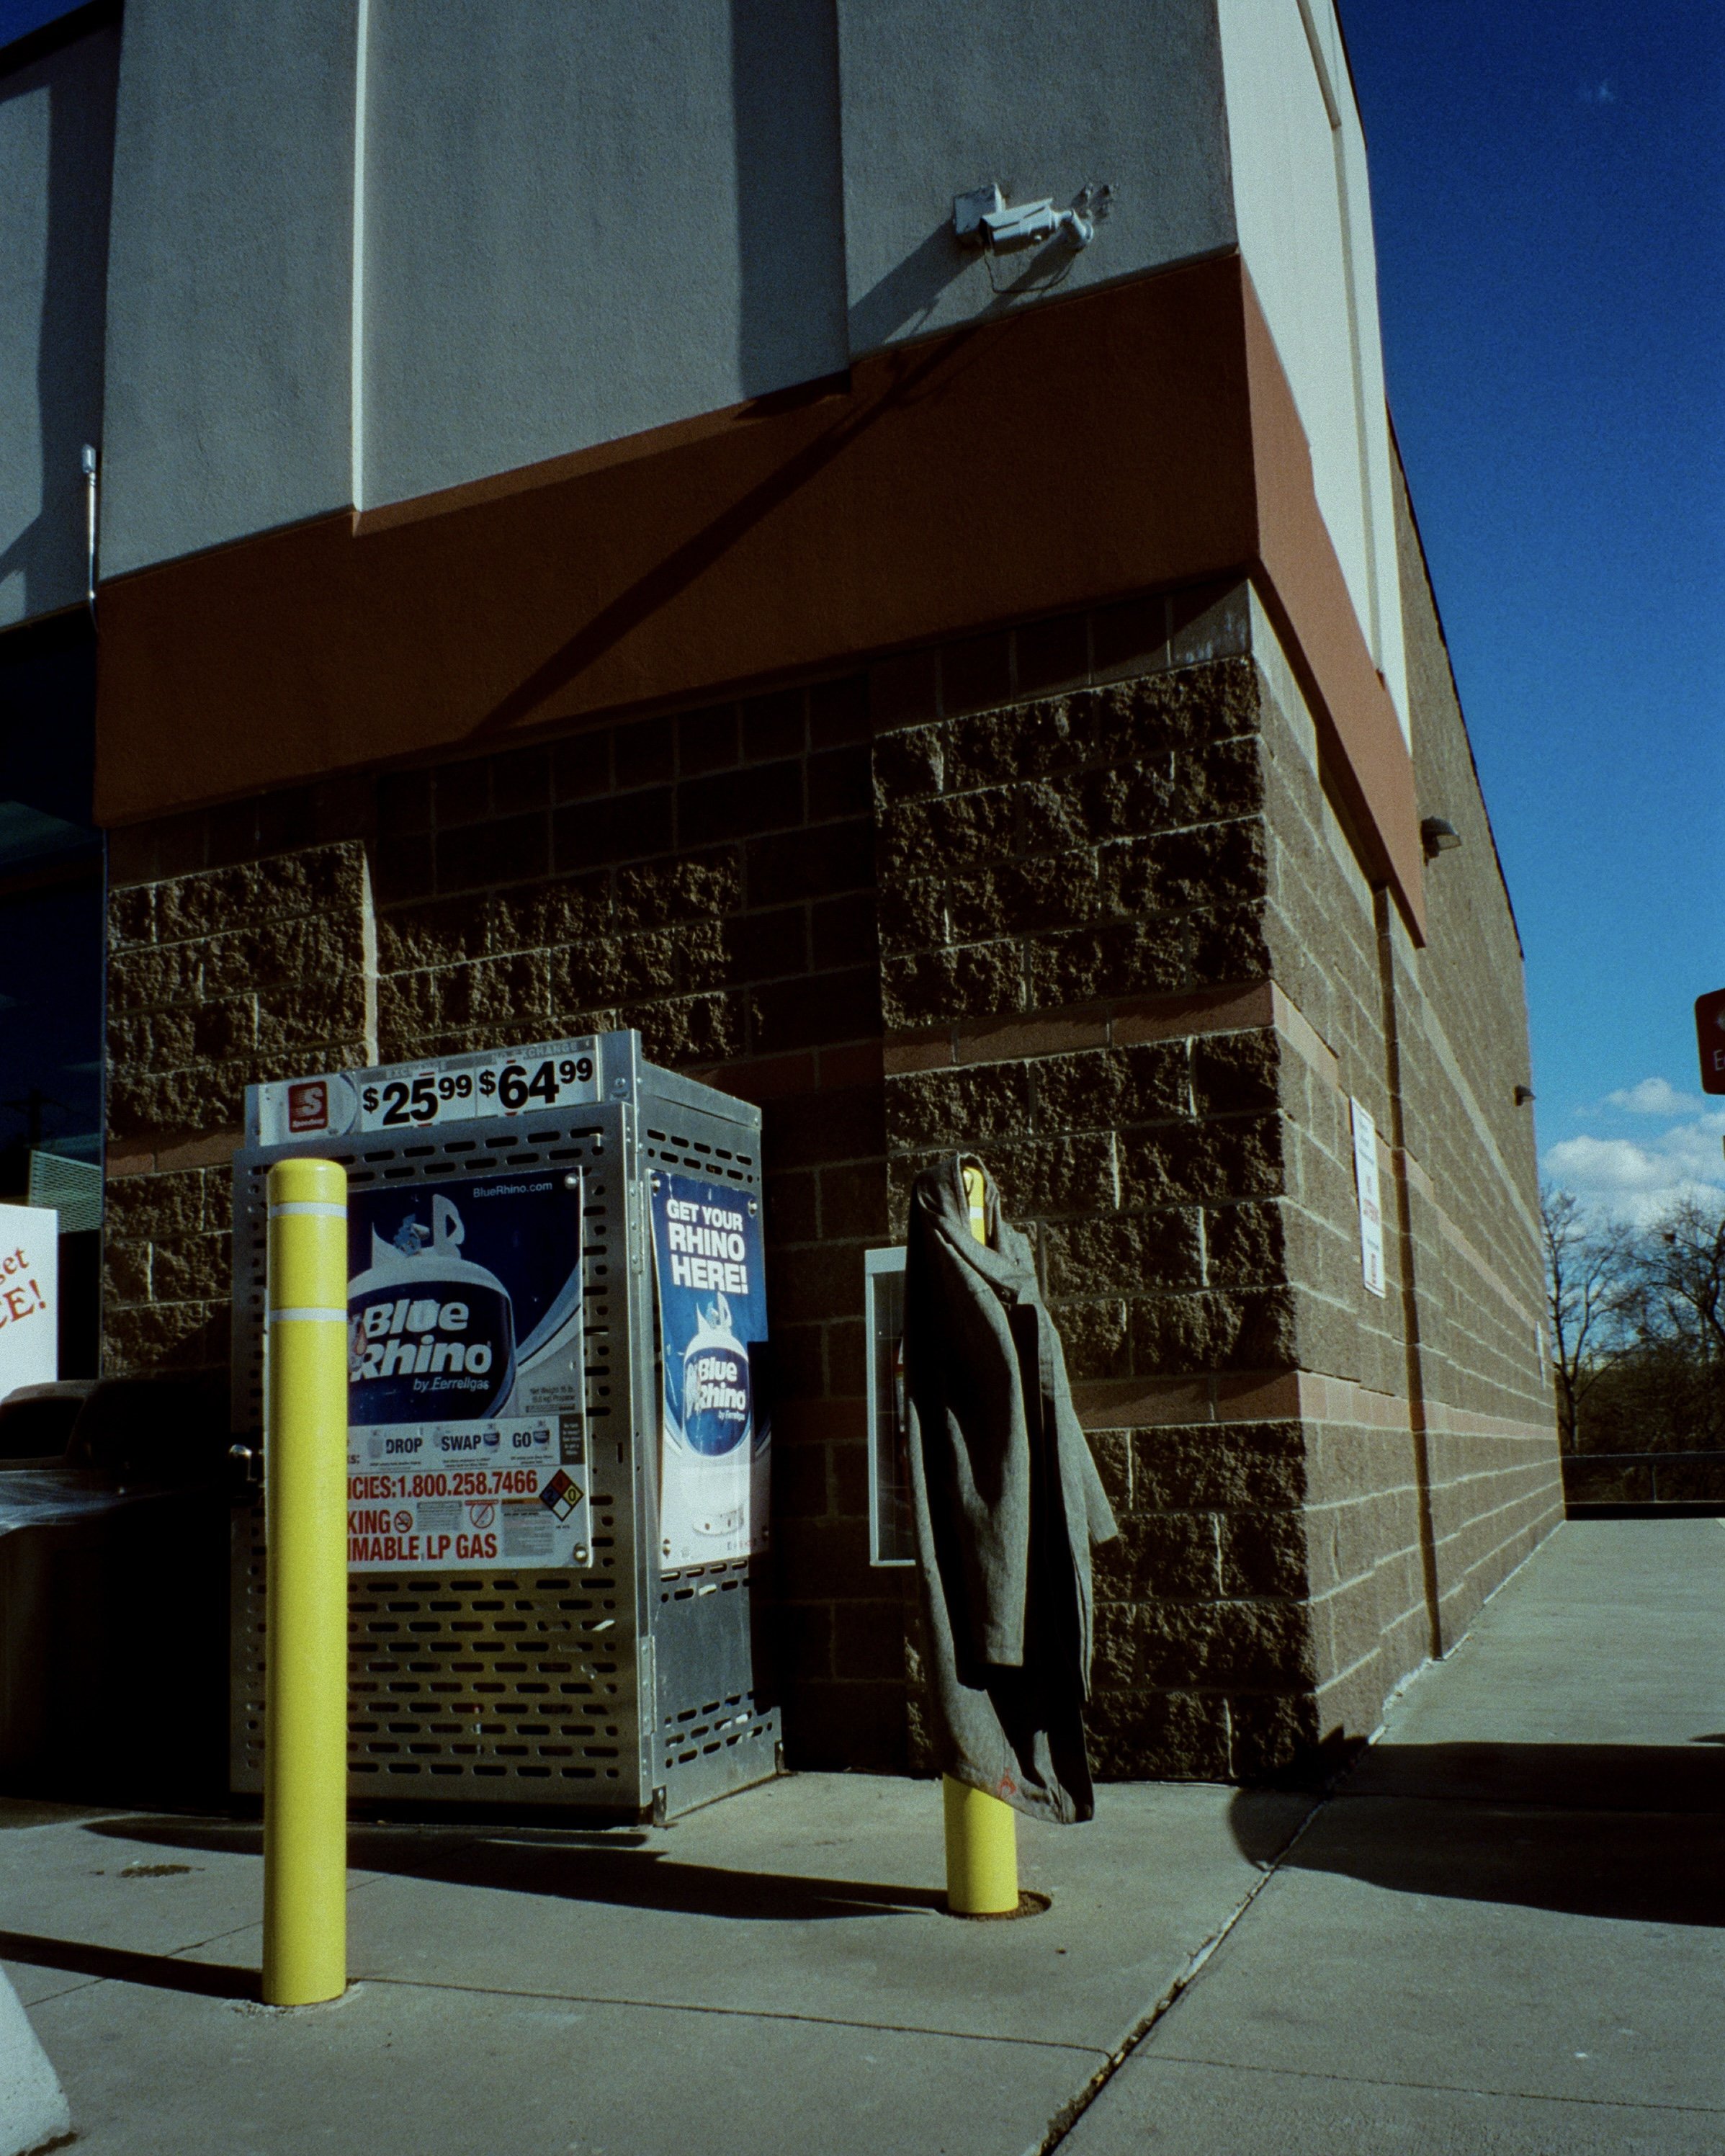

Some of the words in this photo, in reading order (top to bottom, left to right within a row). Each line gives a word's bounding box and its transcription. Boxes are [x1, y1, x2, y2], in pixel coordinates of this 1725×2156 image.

[1713, 1049, 1725, 1071] E
[472, 1181, 553, 1198] BlueRhino.com
[667, 1199, 699, 1222] GET
[702, 1206, 743, 1232] YOUR
[668, 1222, 745, 1261] RHINO
[671, 1253, 748, 1294] HERE!
[0, 1279, 46, 1328] E!
[363, 1299, 469, 1338] Blue
[350, 1335, 492, 1382] Rhino
[699, 1356, 738, 1382] Blue
[413, 1378, 429, 1392] by
[698, 1382, 746, 1410] Rhino
[386, 1438, 424, 1454] DROP
[441, 1434, 482, 1452] SWAP
[512, 1431, 532, 1448] GO
[426, 1534, 452, 1560] LP
[456, 1532, 498, 1559] GAS
